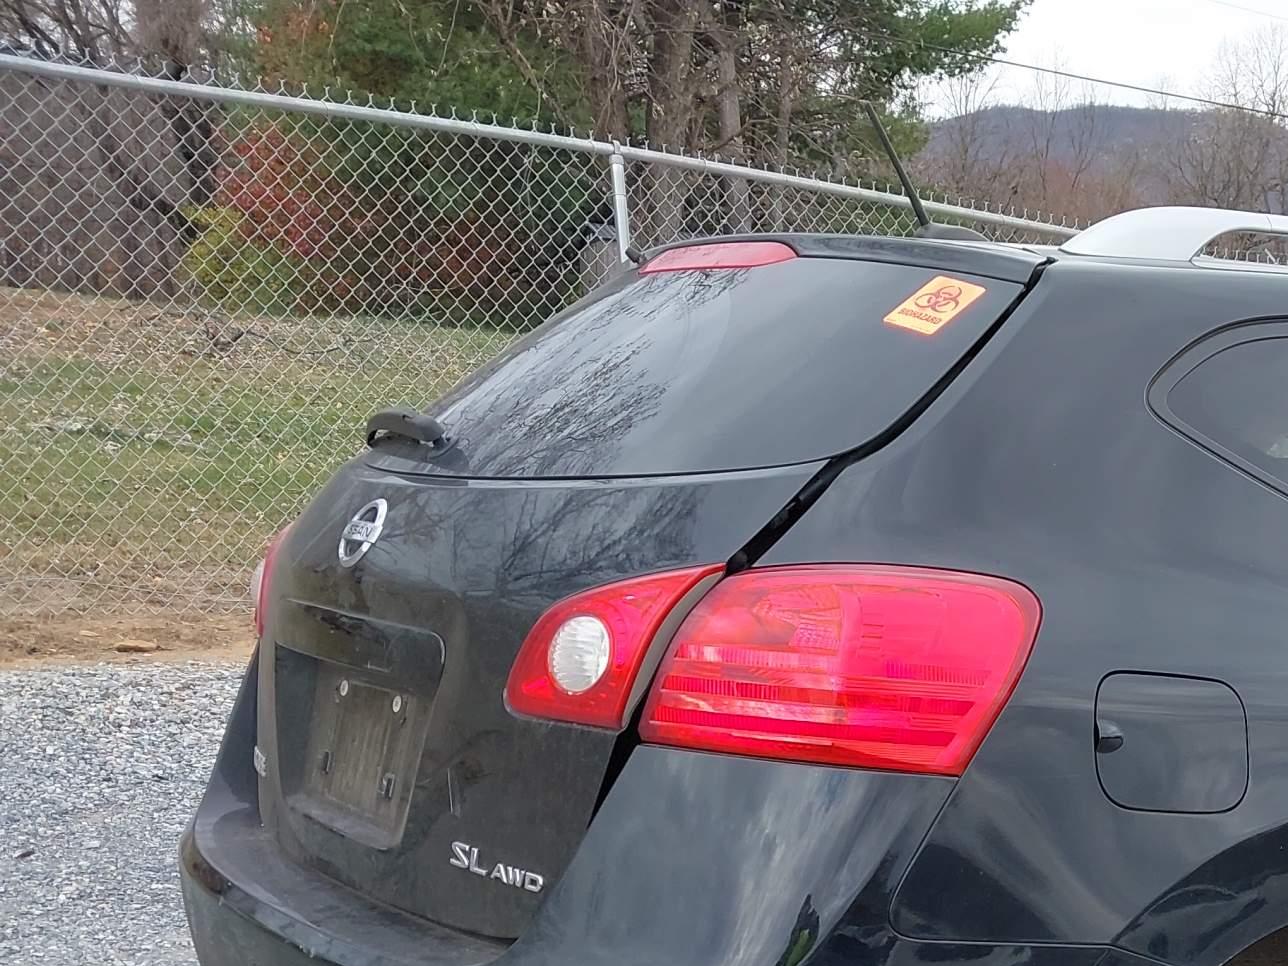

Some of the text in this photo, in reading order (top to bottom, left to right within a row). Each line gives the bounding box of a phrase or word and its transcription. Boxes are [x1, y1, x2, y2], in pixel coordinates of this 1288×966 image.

[898, 308, 942, 324] BIOHAZARD
[449, 841, 544, 893] SL AWD
